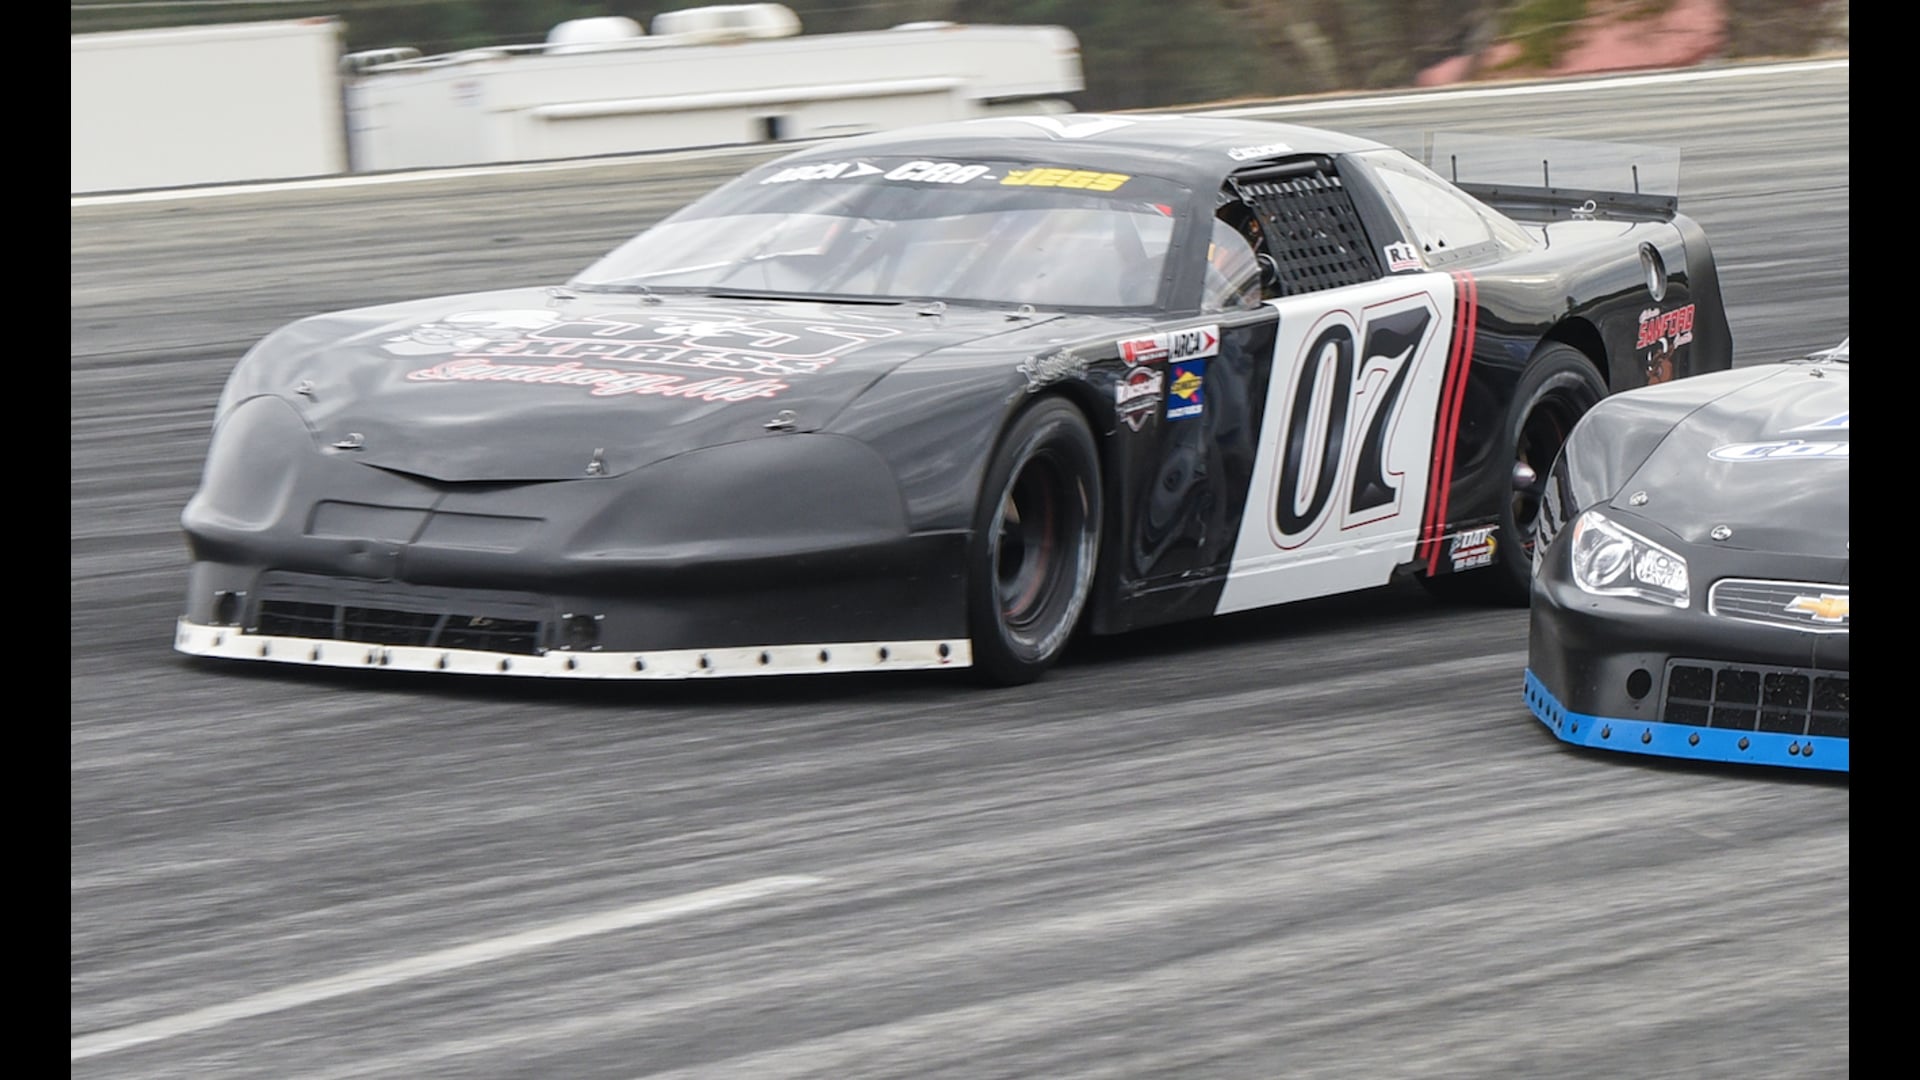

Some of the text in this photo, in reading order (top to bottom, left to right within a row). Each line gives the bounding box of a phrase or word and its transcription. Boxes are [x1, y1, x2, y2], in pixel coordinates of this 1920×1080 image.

[883, 160, 991, 184] CRA
[1000, 167, 1132, 192] JEGS
[1636, 303, 1695, 350] SANFORD
[452, 340, 837, 376] EXPRESS
[1273, 301, 1434, 540] 07
